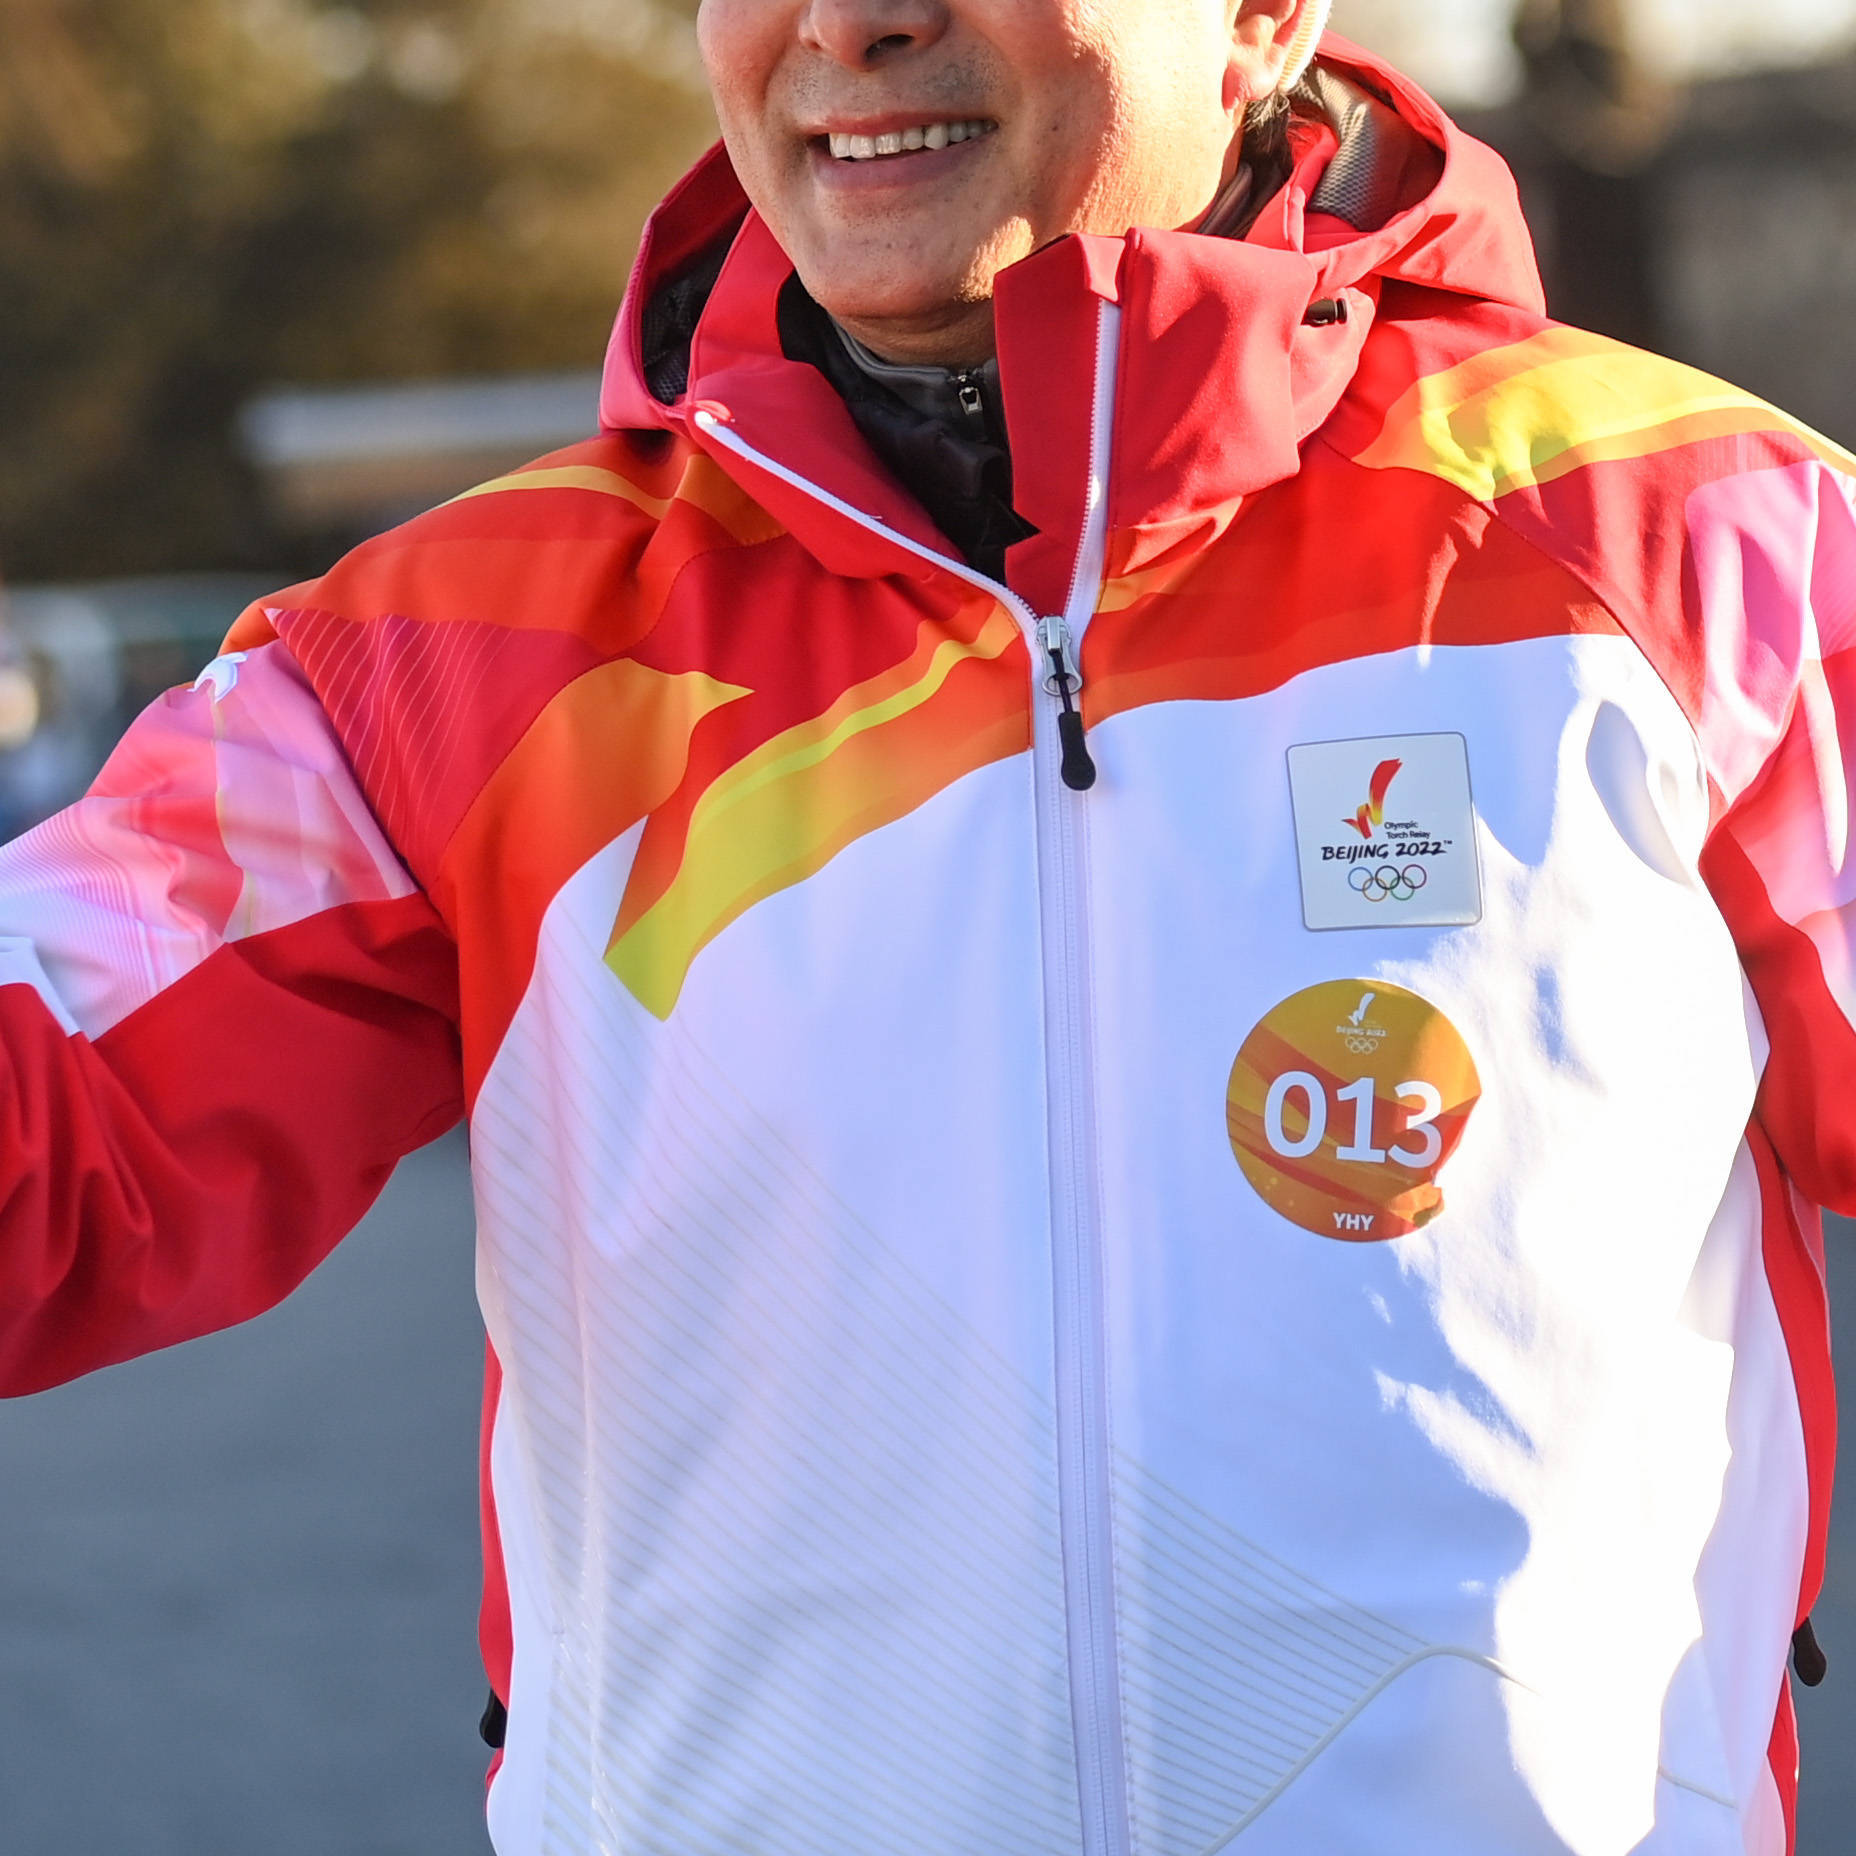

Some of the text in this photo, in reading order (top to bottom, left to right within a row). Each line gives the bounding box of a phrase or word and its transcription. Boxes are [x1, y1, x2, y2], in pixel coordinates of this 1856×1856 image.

[1384, 820, 1419, 830] Olympic
[1386, 830, 1431, 840] Torch Relay
[1321, 843, 1389, 864] BEIJING
[1264, 1070, 1443, 1169] 013
[1333, 1211, 1375, 1232] YHY
